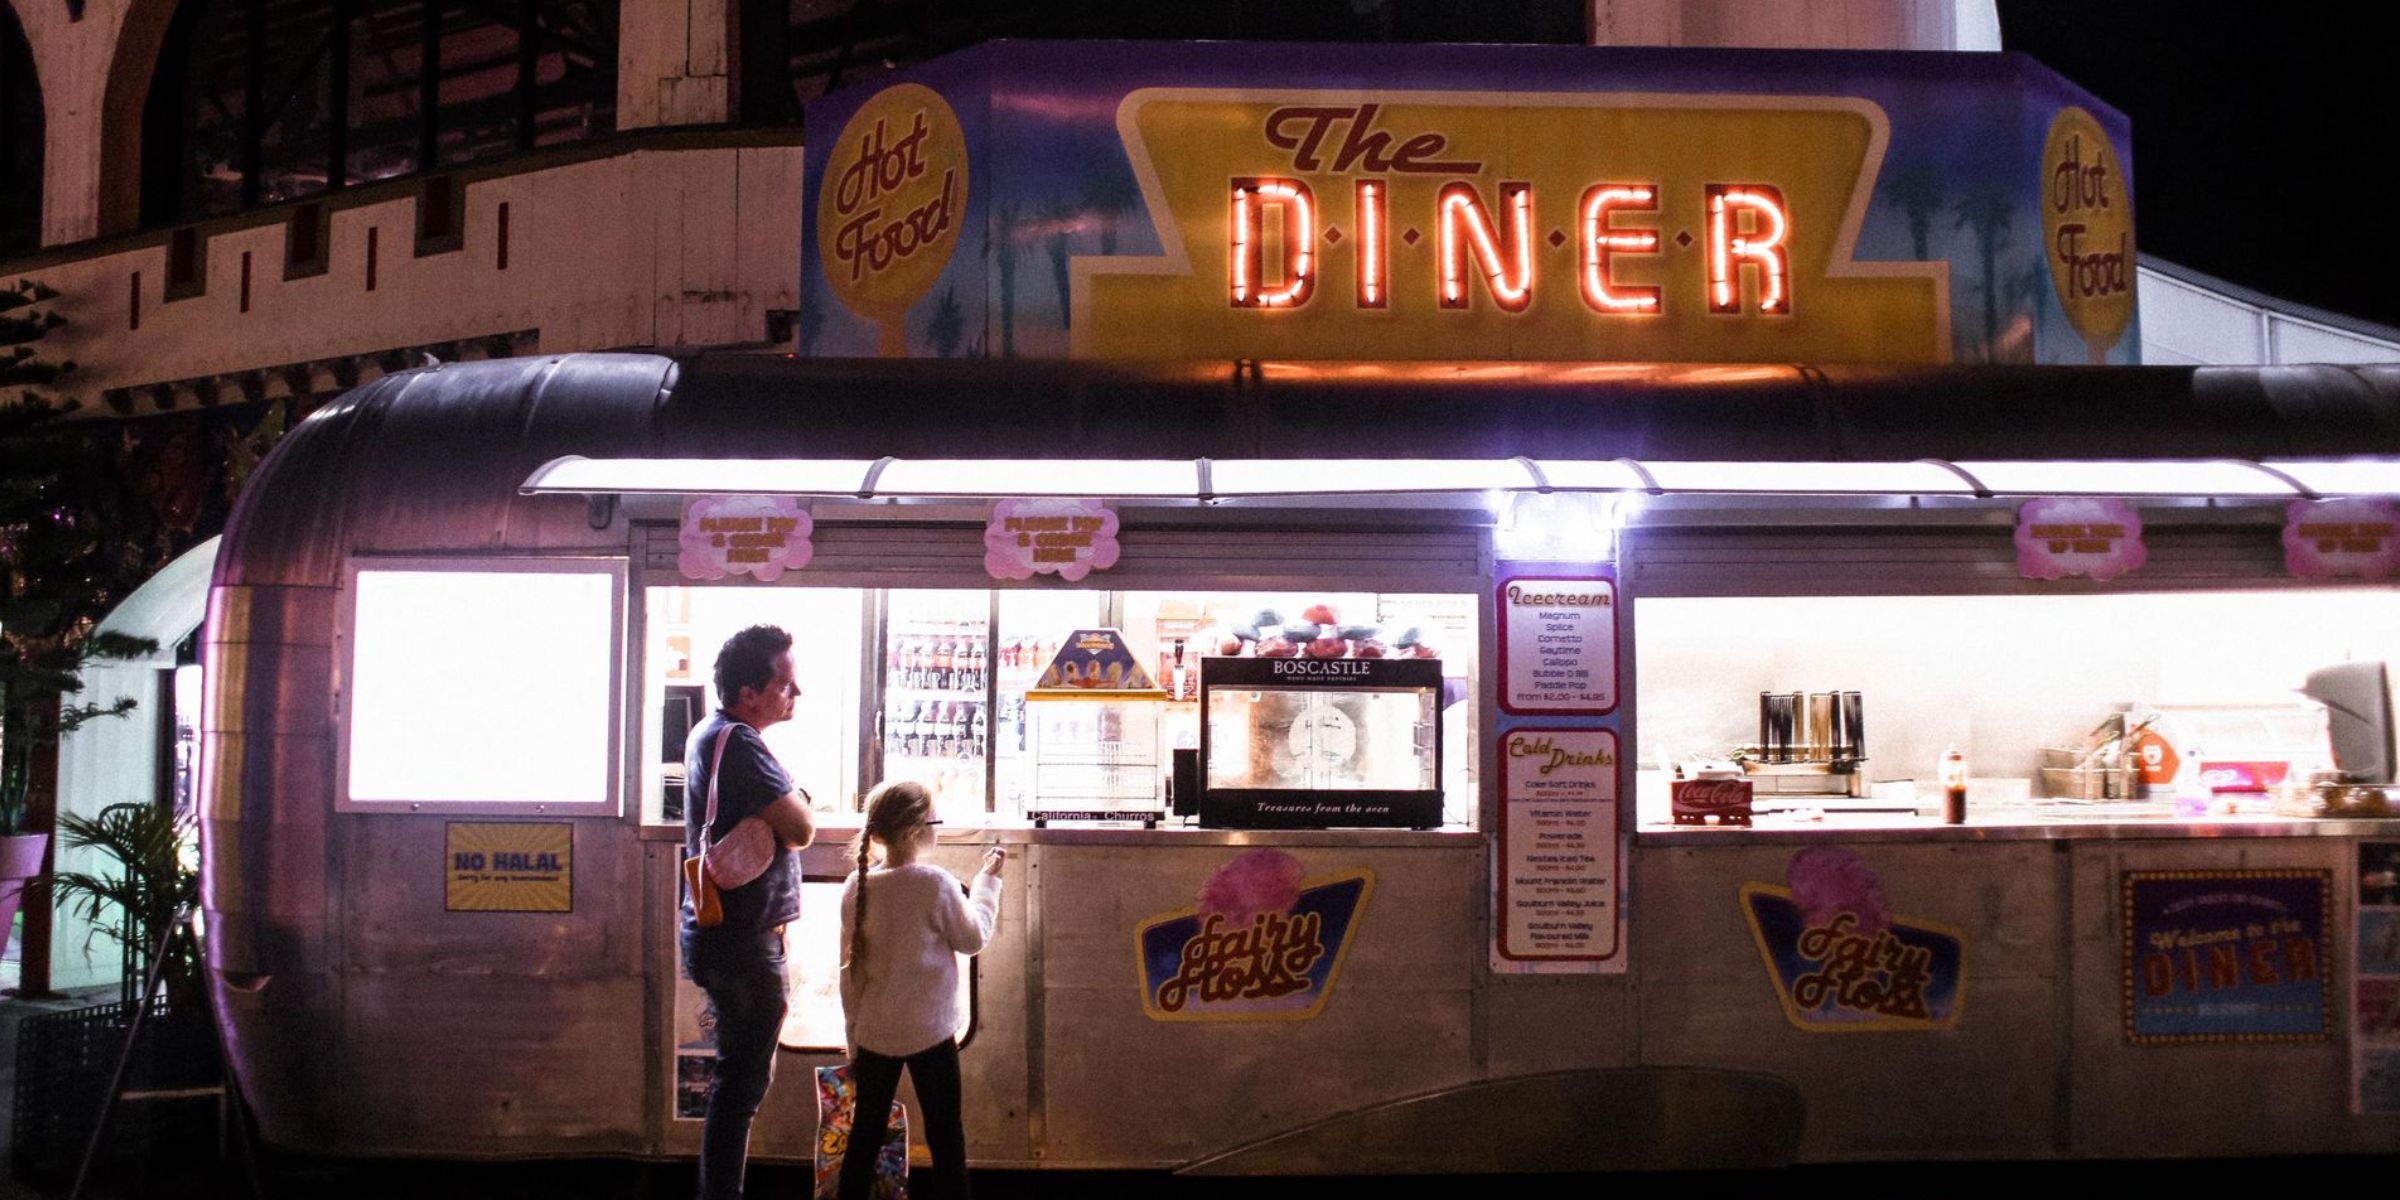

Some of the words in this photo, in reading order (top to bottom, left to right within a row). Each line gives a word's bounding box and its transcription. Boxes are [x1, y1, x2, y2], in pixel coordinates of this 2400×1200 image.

[1264, 103, 1482, 173] The
[836, 112, 929, 214] Hot
[2053, 134, 2109, 214] Hot
[835, 168, 955, 284] Food
[1230, 177, 1790, 314] DINER
[2056, 223, 2128, 299] Food
[1508, 586, 1611, 605] Icecream
[1539, 612, 1580, 620] Magnum
[1546, 623, 1573, 632] Splice
[1538, 635, 1582, 643] Cornetto
[1540, 646, 1580, 655] Gaytime
[1274, 661, 1370, 675] BOSCASTLE
[1508, 737, 1552, 757] Cold
[1540, 748, 1613, 774] Drinks
[1031, 811, 1091, 820] California
[1104, 811, 1155, 821] Churros
[1257, 802, 1311, 812] Treasures
[1313, 803, 1341, 814] from
[1345, 803, 1361, 812] the
[455, 853, 485, 870] NO
[493, 853, 563, 871] HALAL
[2142, 938, 2315, 998] DINER
